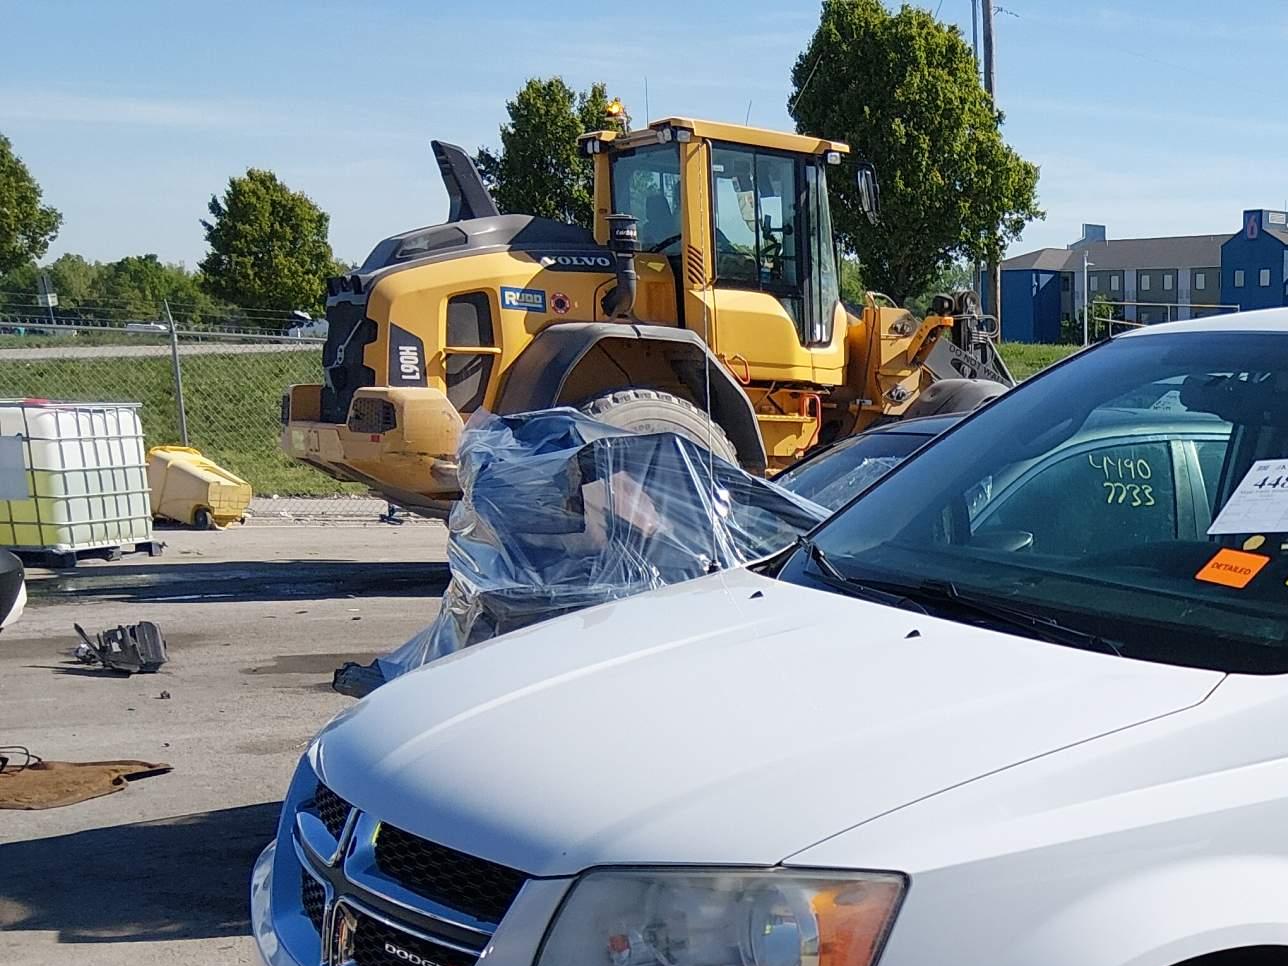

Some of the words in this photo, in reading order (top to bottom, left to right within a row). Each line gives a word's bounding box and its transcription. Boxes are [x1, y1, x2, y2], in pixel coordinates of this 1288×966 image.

[541, 256, 611, 267] VOLVO
[399, 346, 420, 380] L90H
[1104, 482, 1155, 506] 7733
[1211, 562, 1252, 576] DETAILED
